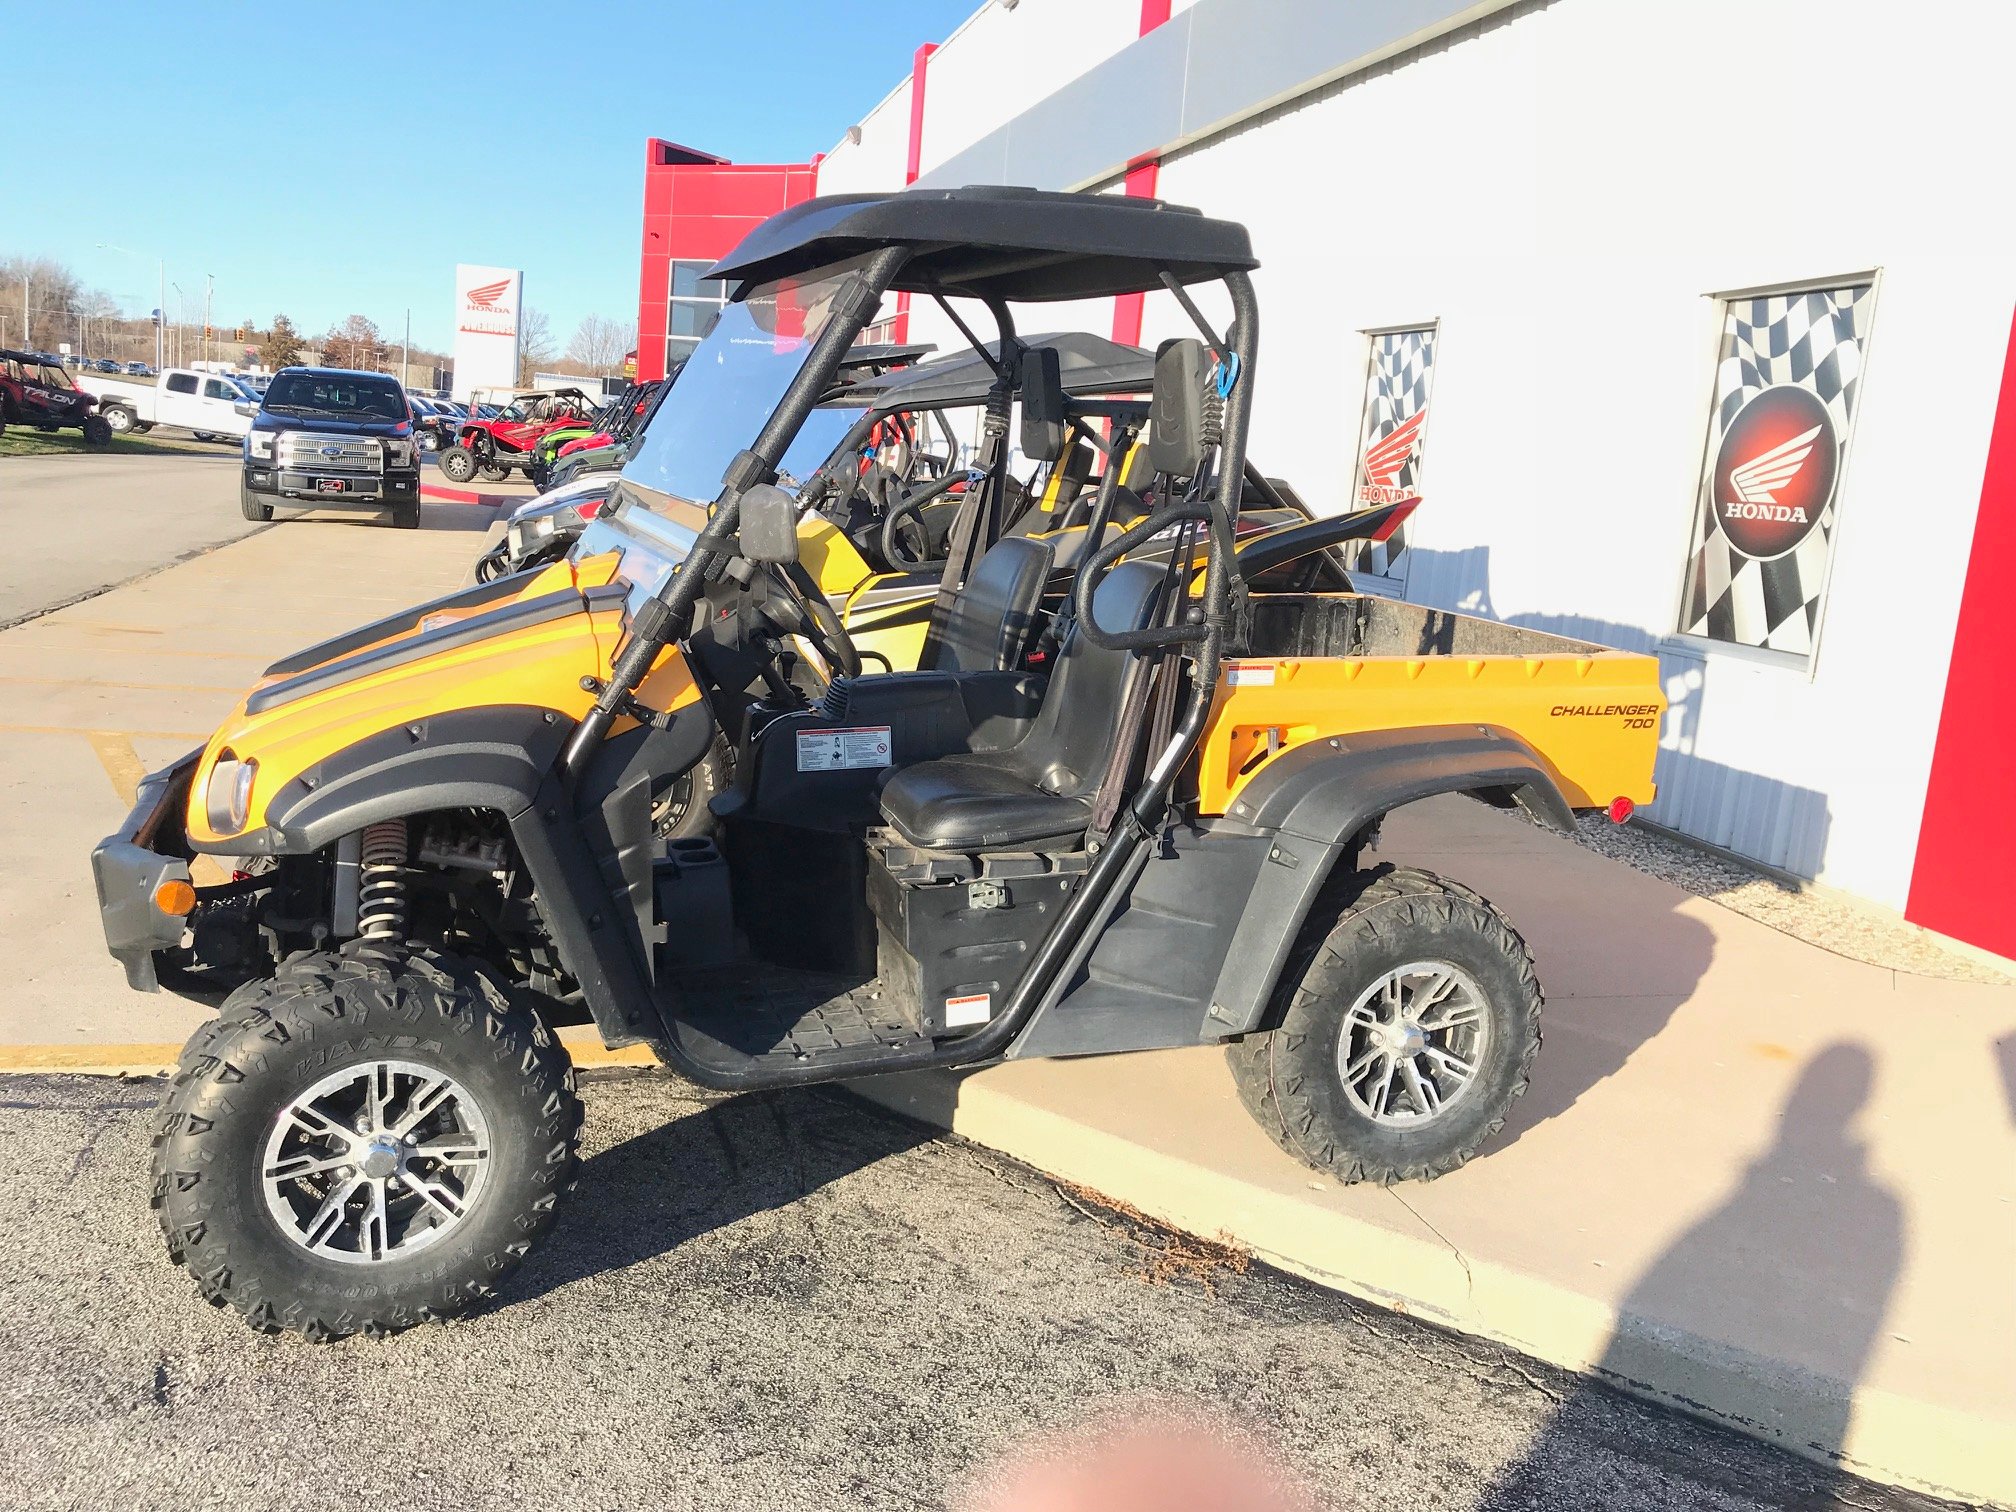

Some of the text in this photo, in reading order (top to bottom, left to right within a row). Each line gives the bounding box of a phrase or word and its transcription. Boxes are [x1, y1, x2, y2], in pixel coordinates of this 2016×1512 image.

[466, 304, 511, 315] HONDA
[23, 385, 76, 406] TALON
[1725, 502, 1808, 524] HONDA
[1550, 704, 1660, 717] CHALLENGER
[1622, 718, 1656, 730] 700
